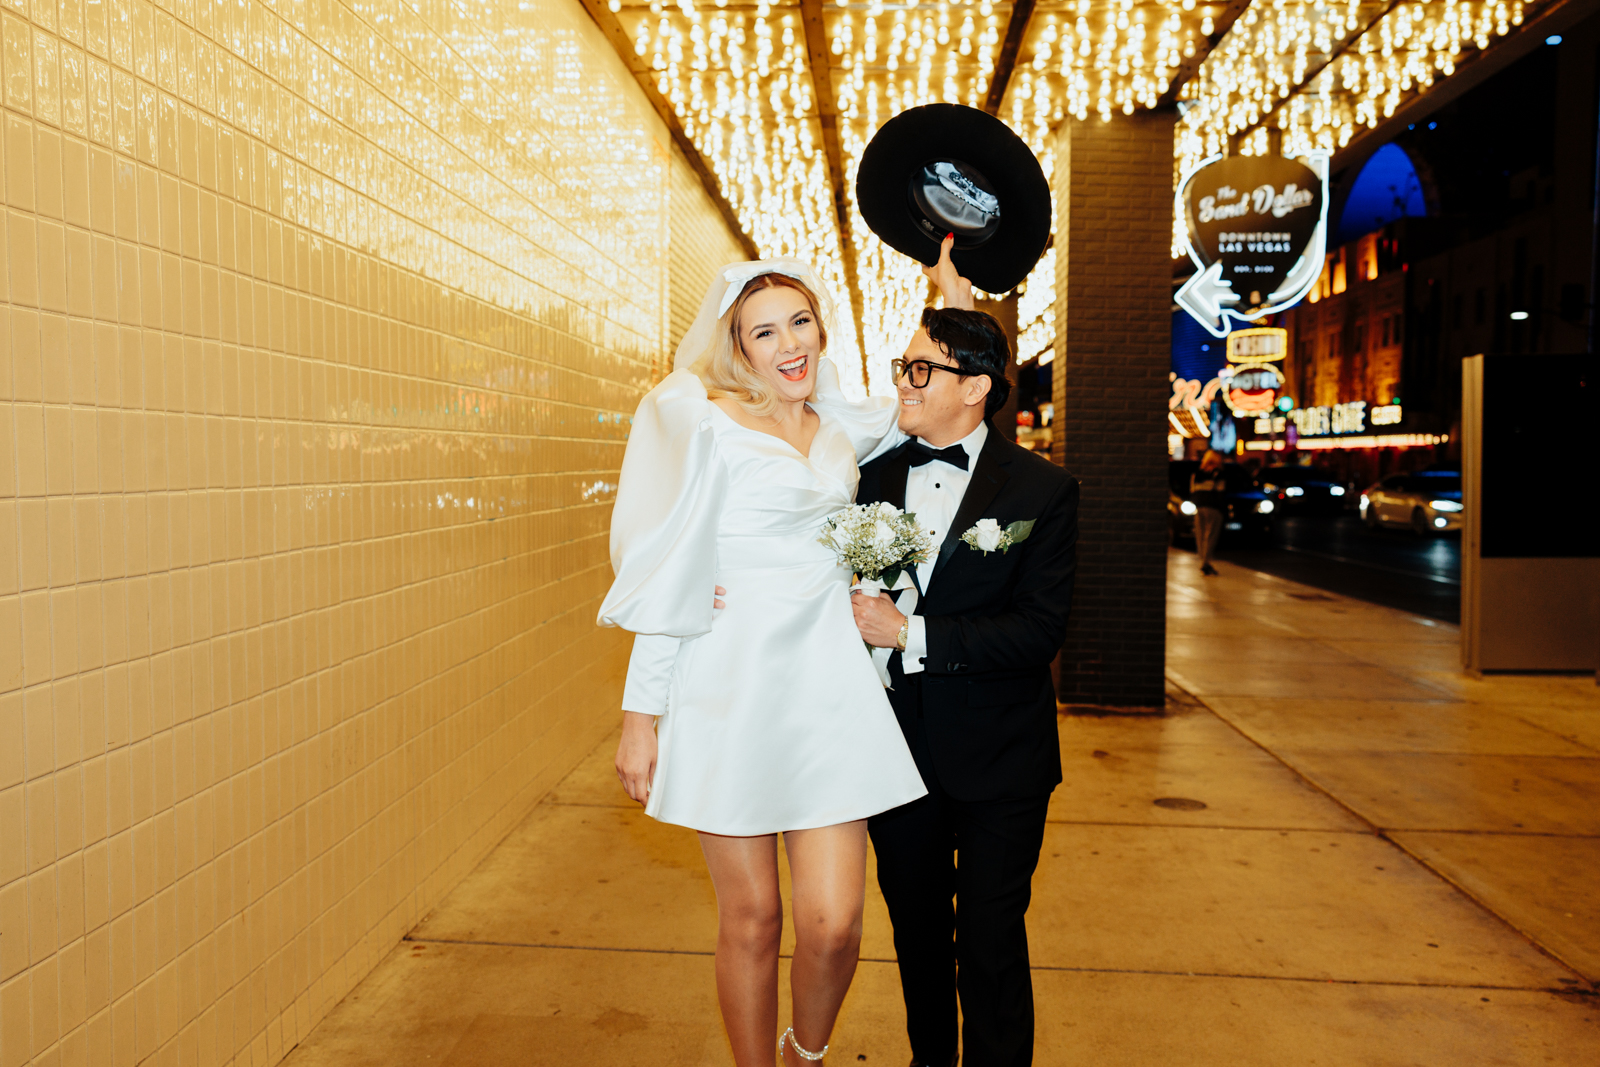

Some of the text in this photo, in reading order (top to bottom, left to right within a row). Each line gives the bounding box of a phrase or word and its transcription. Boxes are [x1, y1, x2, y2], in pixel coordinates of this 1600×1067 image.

[1217, 185, 1237, 199] The
[1198, 183, 1313, 223] Sand Dollar
[1218, 232, 1291, 242] DOWNTOWN
[1218, 242, 1292, 254] LAS VEGAS
